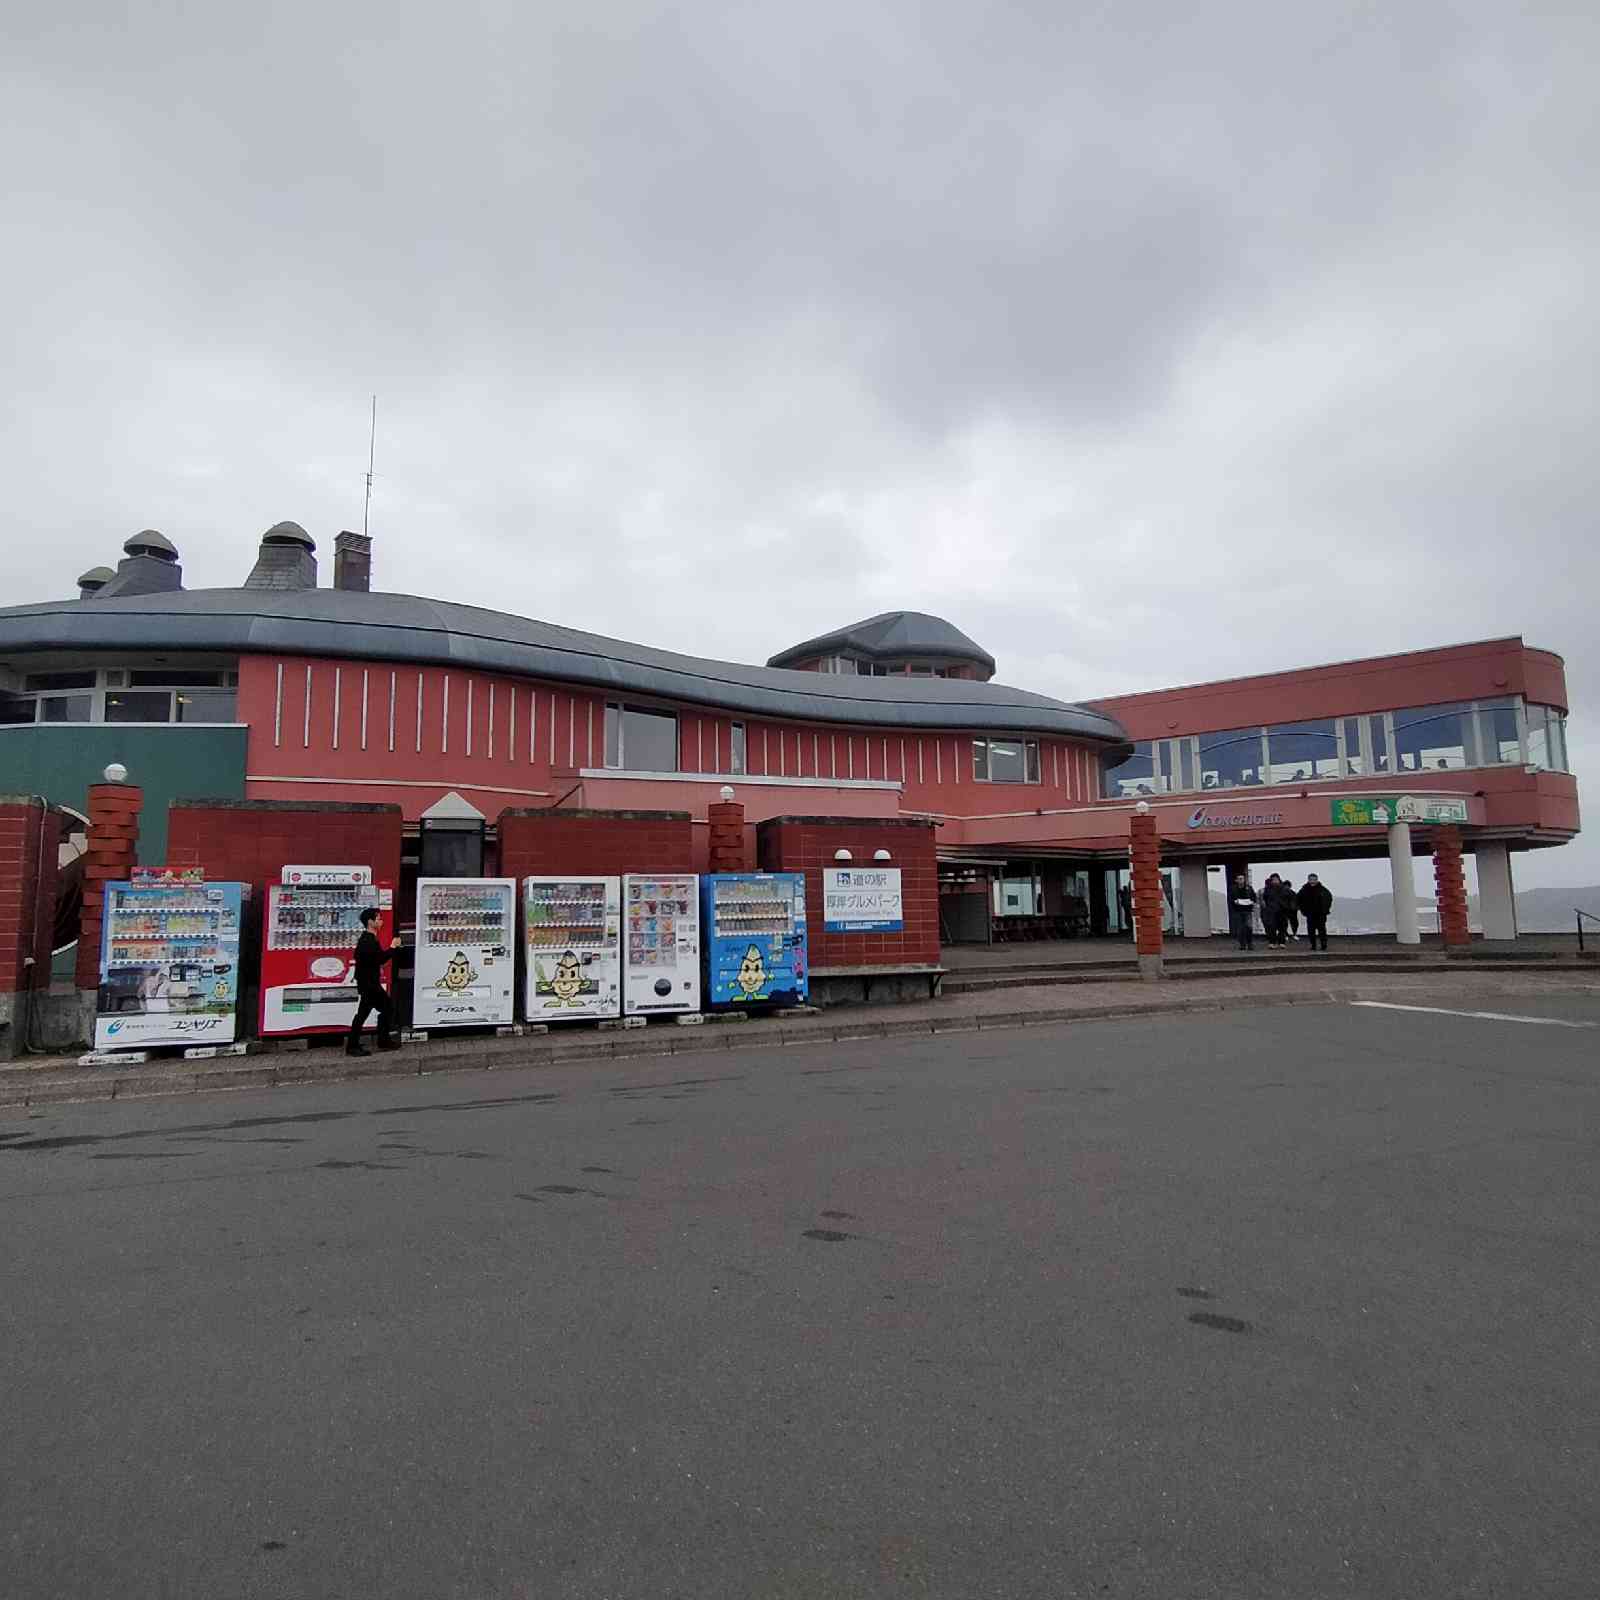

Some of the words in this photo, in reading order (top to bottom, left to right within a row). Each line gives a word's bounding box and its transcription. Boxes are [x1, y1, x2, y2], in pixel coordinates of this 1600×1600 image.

[852, 873, 888, 887] 道の駅
[826, 894, 900, 909] 厚岸グルメパーク
